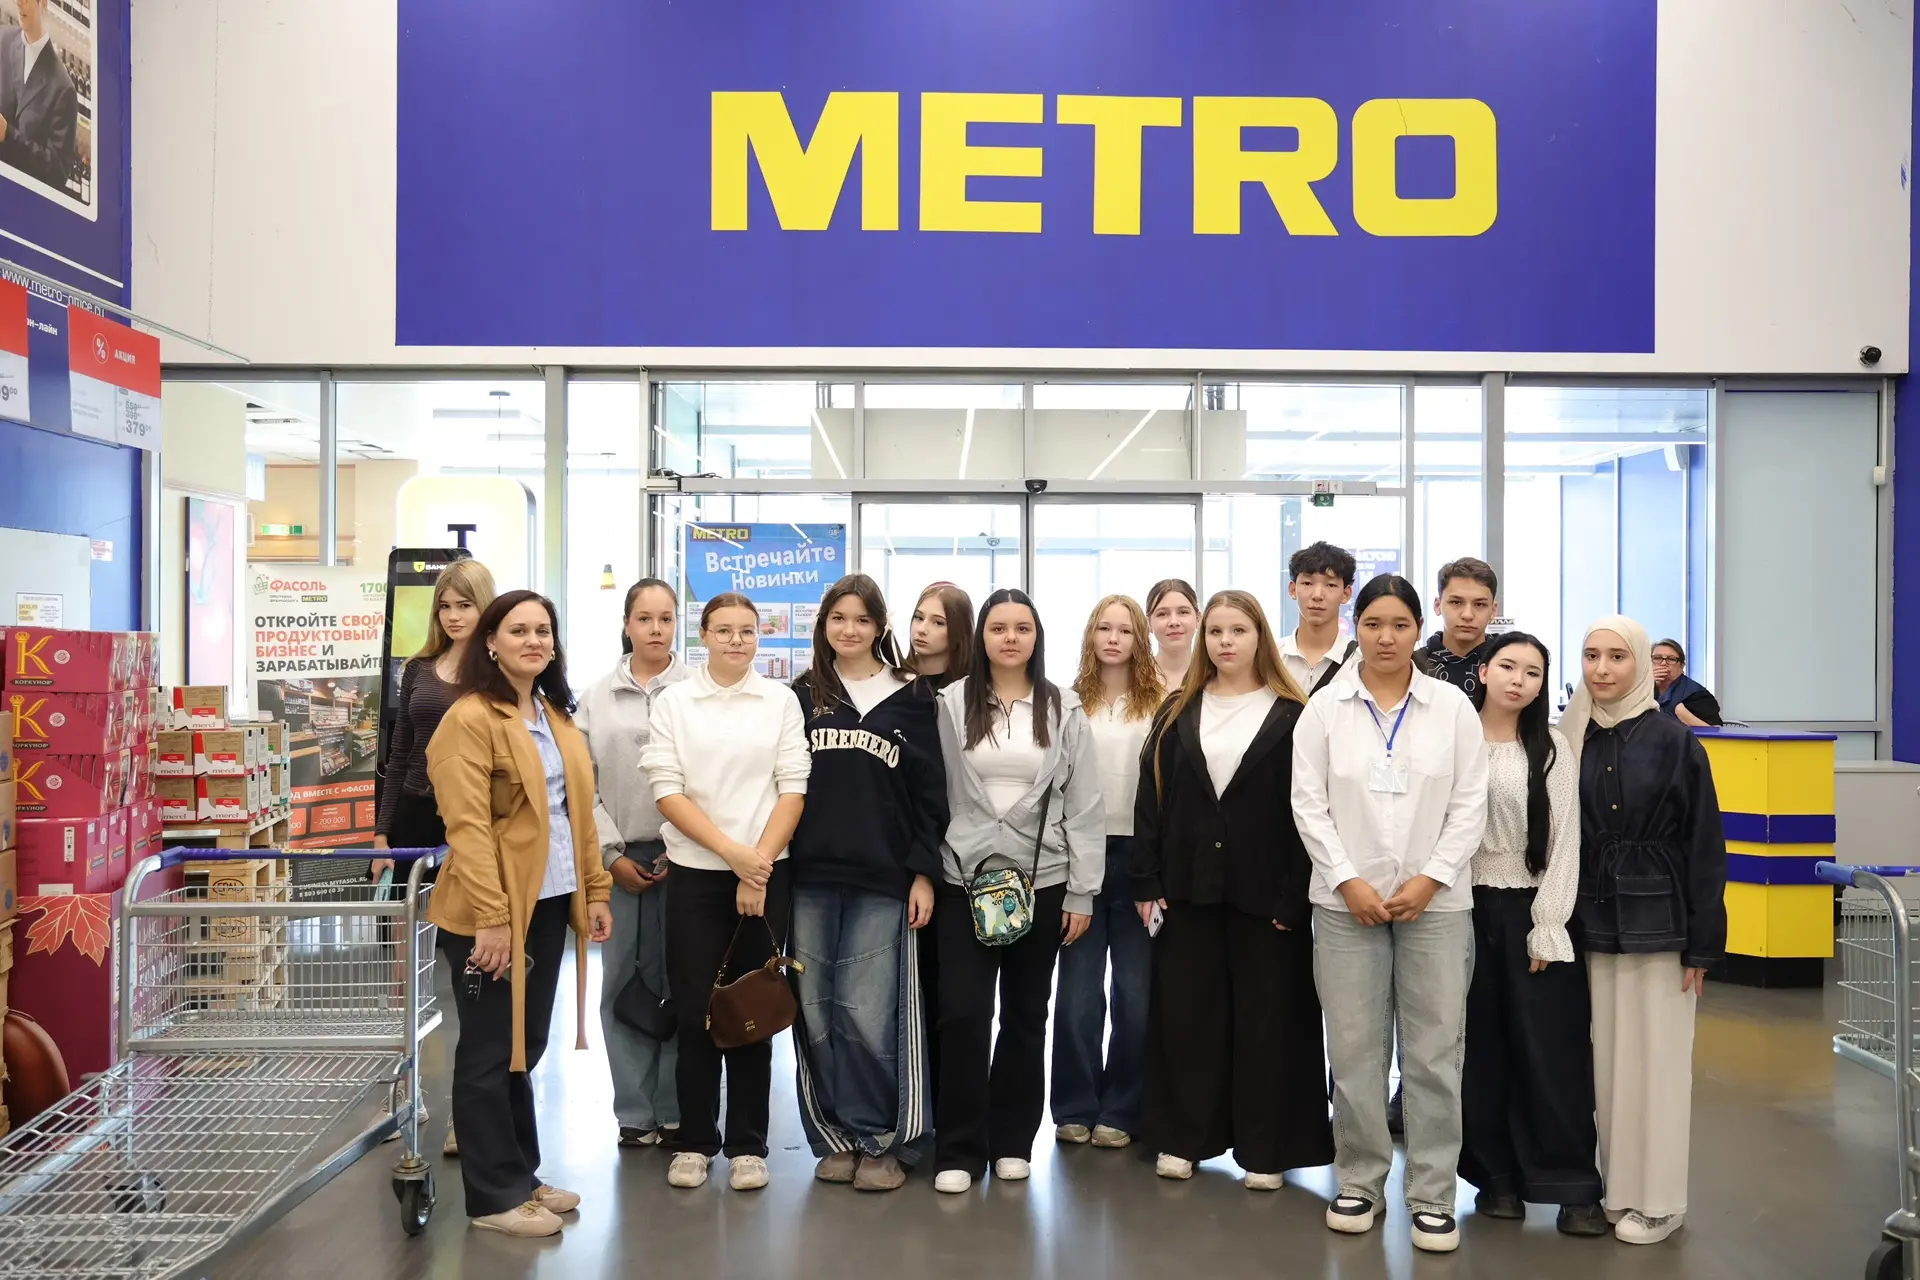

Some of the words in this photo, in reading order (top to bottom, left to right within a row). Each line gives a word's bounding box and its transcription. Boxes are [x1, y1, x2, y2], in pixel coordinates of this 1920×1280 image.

[711, 91, 1497, 236] METRO
[114, 349, 136, 364] АКЦИЯ
[126, 420, 145, 436] 379
[692, 527, 749, 541] METRO
[705, 542, 836, 574] Встречайте
[269, 579, 328, 592] ФАСОЛЬ
[731, 570, 819, 591] Новинки
[254, 612, 337, 628] ОТКРОЙТЕ
[341, 611, 384, 627] СВОЙ
[255, 627, 378, 644] ПРОДУКТОВЫЙ
[256, 644, 317, 658] БИЗНЕС
[322, 644, 334, 656] И
[811, 728, 900, 768] SIRENHERO
[303, 788, 333, 798] ВМЕСТЕ
